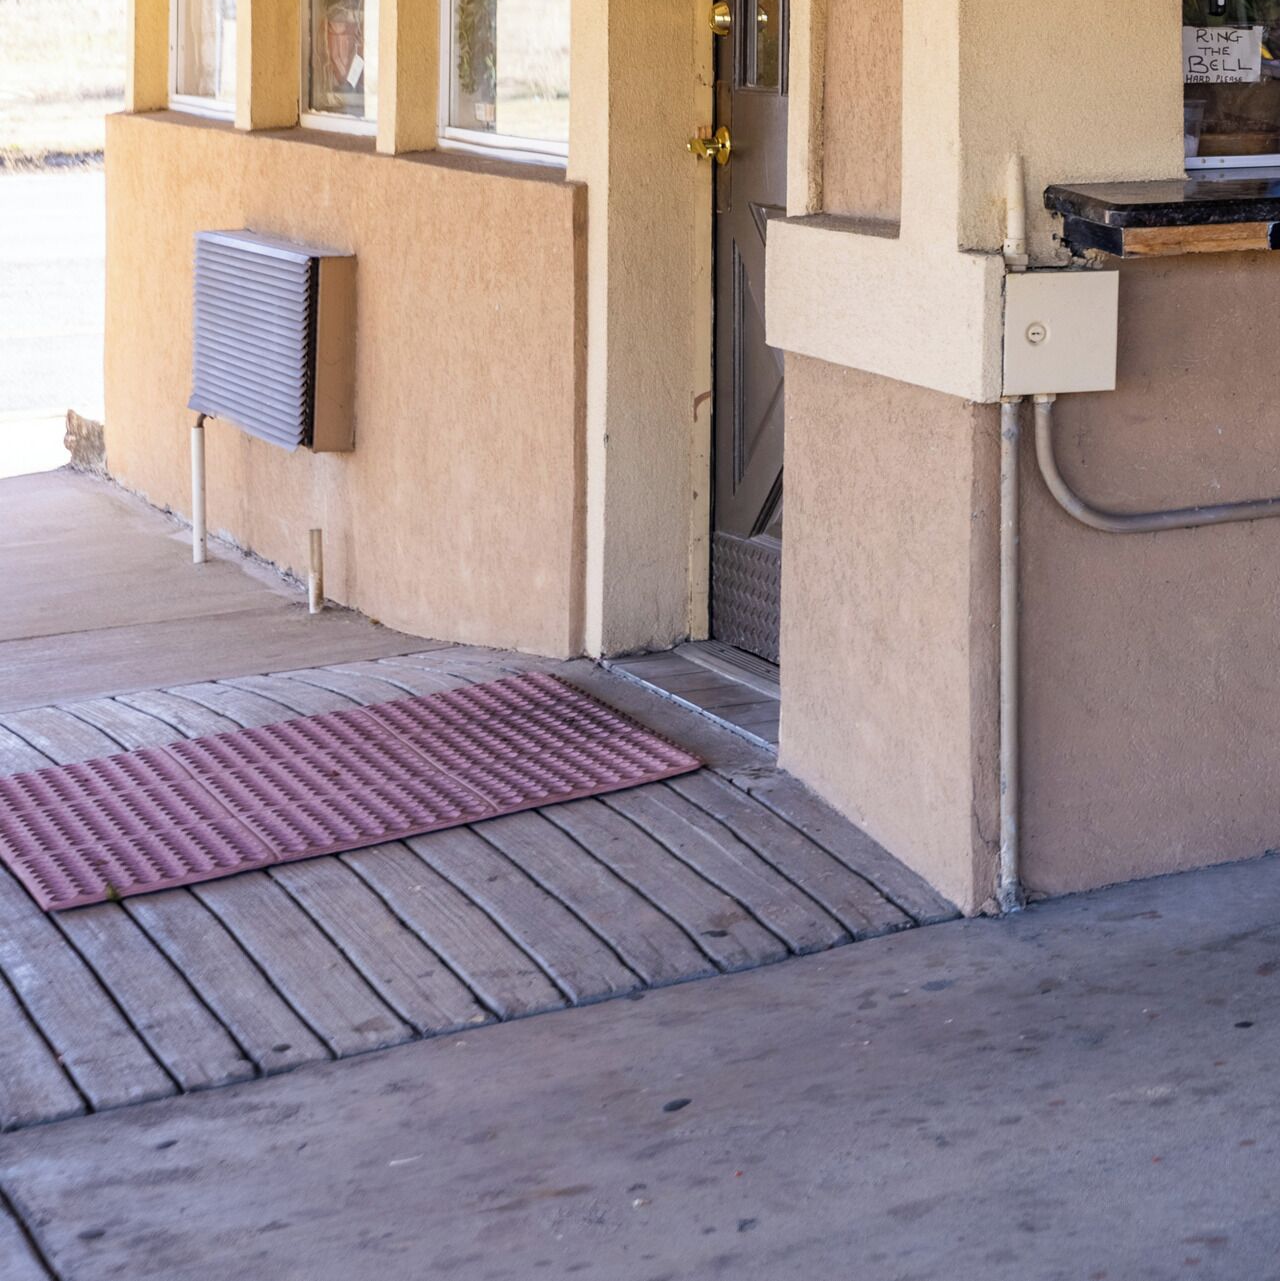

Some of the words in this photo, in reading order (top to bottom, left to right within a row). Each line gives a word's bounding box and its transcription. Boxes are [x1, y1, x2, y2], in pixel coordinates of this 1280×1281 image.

[1196, 28, 1243, 44] RING
[1198, 46, 1231, 56] THE
[1188, 55, 1253, 74] BELL
[1186, 74, 1211, 83] HARD
